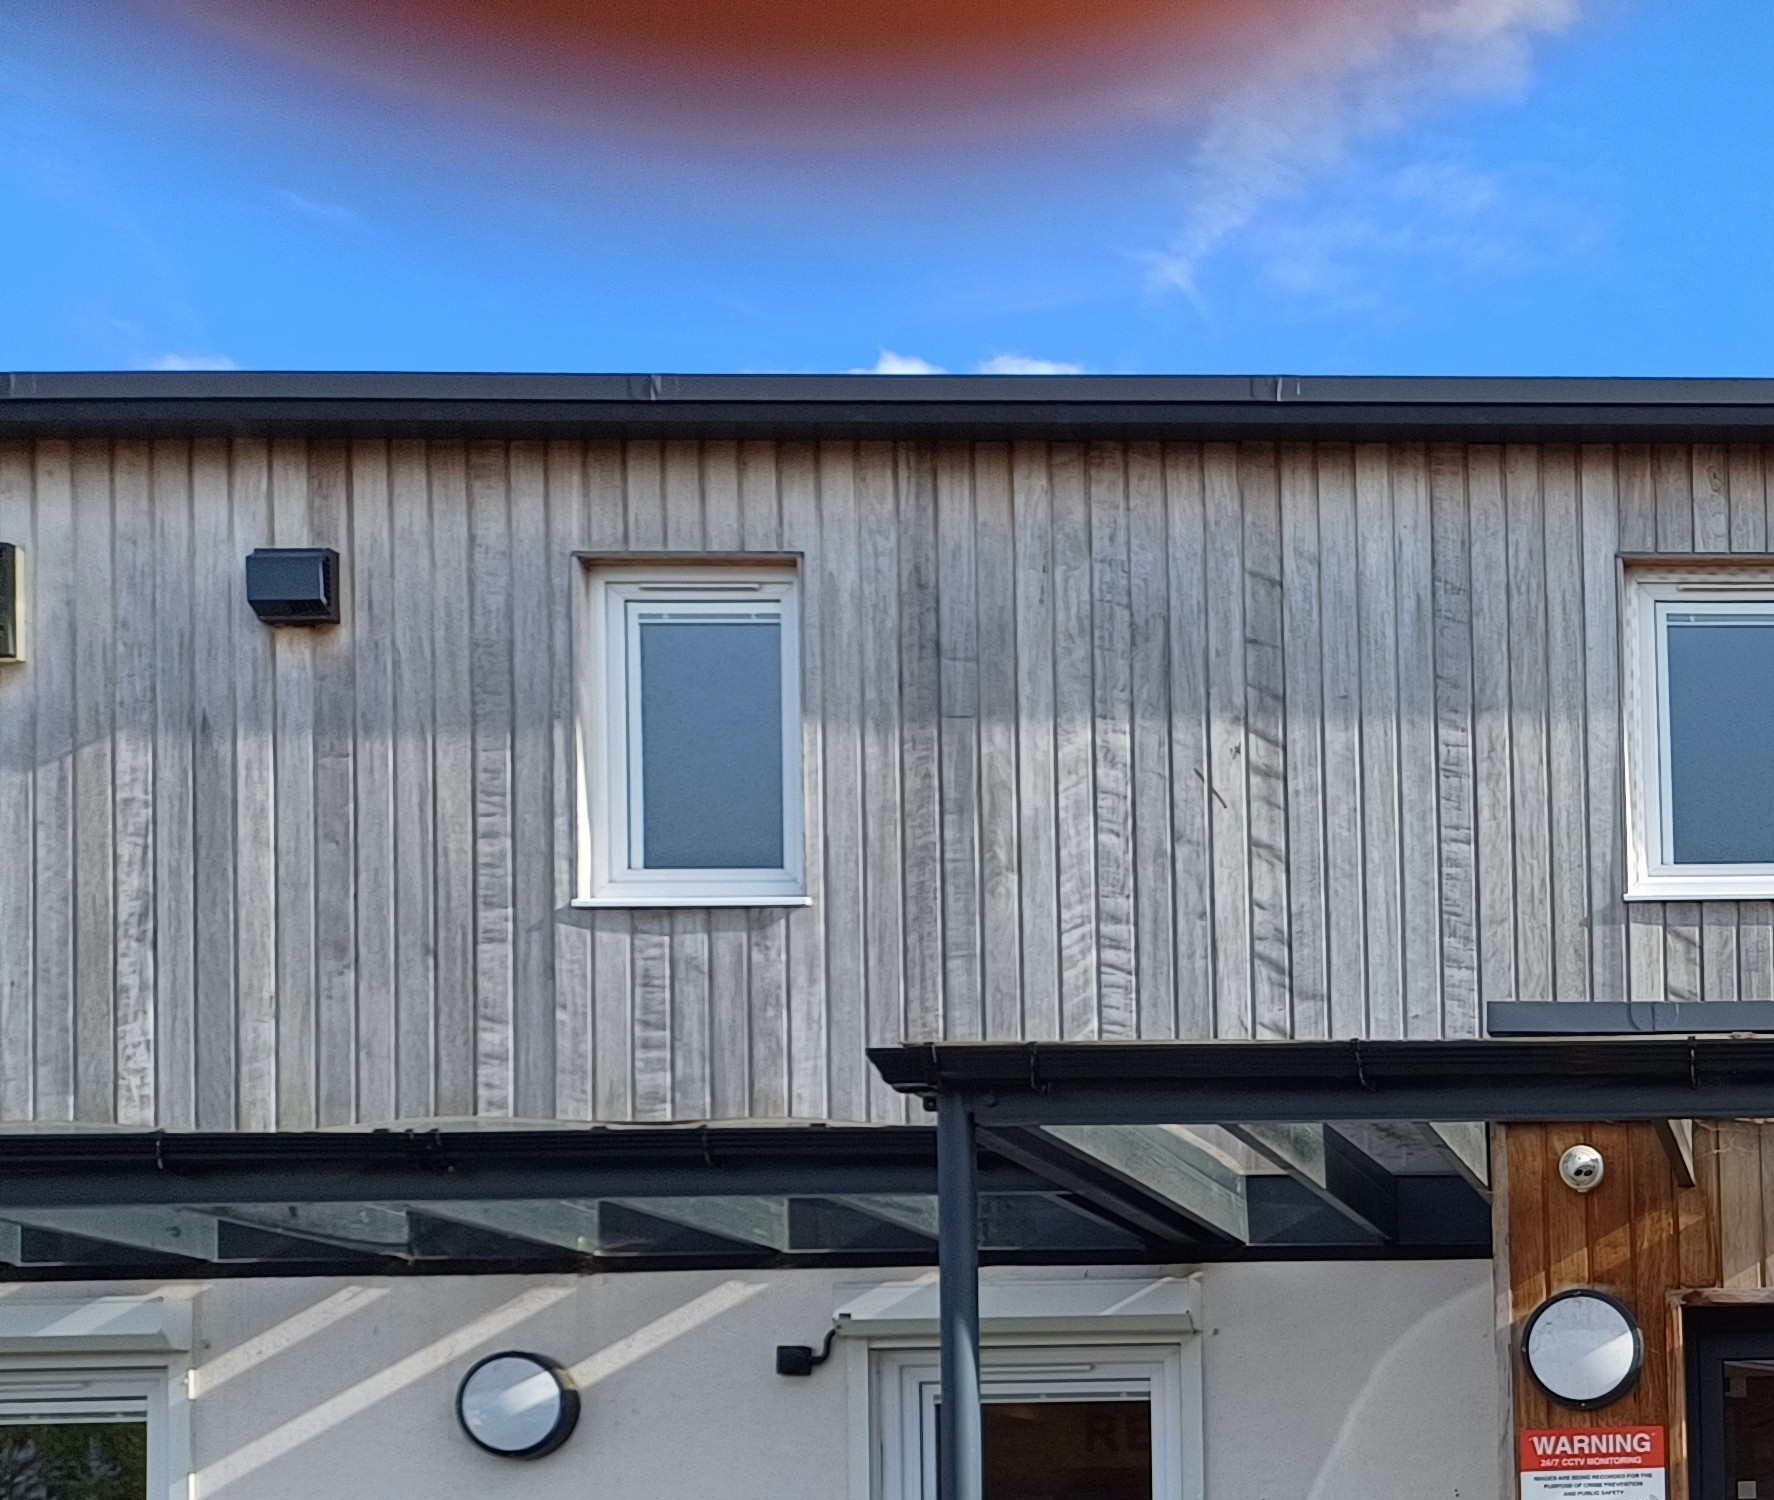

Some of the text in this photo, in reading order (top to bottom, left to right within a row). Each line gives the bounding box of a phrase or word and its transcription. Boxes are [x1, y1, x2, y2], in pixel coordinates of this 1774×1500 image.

[1532, 1433, 1651, 1455] WARNING
[1562, 1457, 1584, 1466] CCTV
[1586, 1456, 1641, 1465] MONITORING
